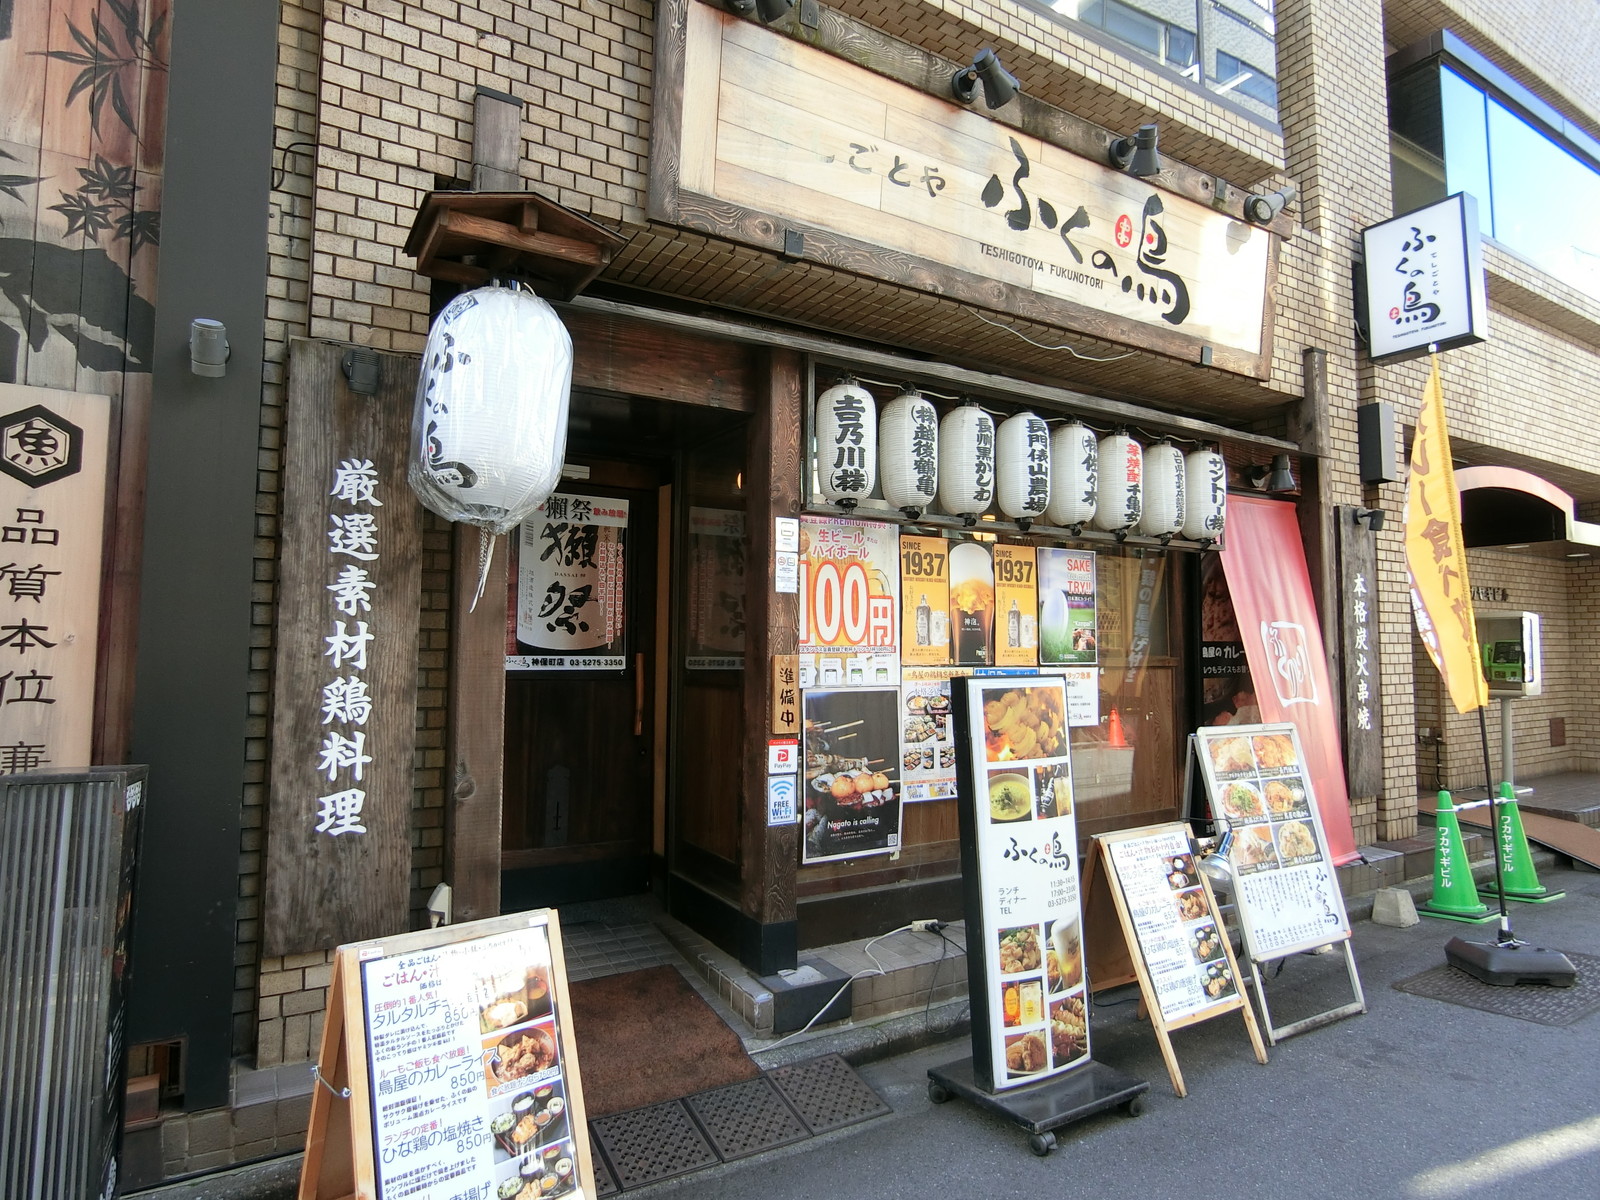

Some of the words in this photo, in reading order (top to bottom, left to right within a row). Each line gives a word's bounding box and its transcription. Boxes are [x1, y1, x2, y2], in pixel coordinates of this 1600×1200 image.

[980, 242, 1044, 272] TESHIGOTOYA
[1050, 264, 1104, 290] FUKUNOTORI
[818, 529, 865, 544] 生ビール
[902, 541, 921, 551] SINCE
[812, 545, 870, 559] ハイボール
[996, 549, 1012, 558] SINCE
[902, 551, 946, 577] 1937
[996, 558, 1034, 583] 1937
[1067, 558, 1091, 573] SAKE
[315, 458, 383, 837] 厳選素材鶏料理
[1353, 573, 1372, 730] 本格炭火串焼
[531, 658, 565, 667] 神保町店
[569, 659, 624, 667] 03-5275-3350
[778, 667, 797, 728] 準備中
[774, 761, 792, 769] PayPay
[771, 807, 792, 817] Wi-Fi
[773, 801, 790, 809] FREE
[827, 818, 851, 830] Nagato
[853, 816, 859, 826] is
[859, 815, 880, 827] calling
[1003, 831, 1071, 871] ふくの鳥
[1501, 815, 1514, 873] ワカヤギビル
[1439, 826, 1452, 889] ワカヤギビル
[998, 886, 1020, 896] ランチ
[999, 896, 1027, 906] ディナー
[1000, 907, 1013, 915] TEL
[378, 1046, 502, 1097] 鳥屋のカレーライス
[450, 1070, 486, 1091] 850円
[382, 1115, 484, 1164] ひな鶏の塩焼き
[384, 1118, 443, 1146] ランチの定番!
[456, 1132, 492, 1154] 850円
